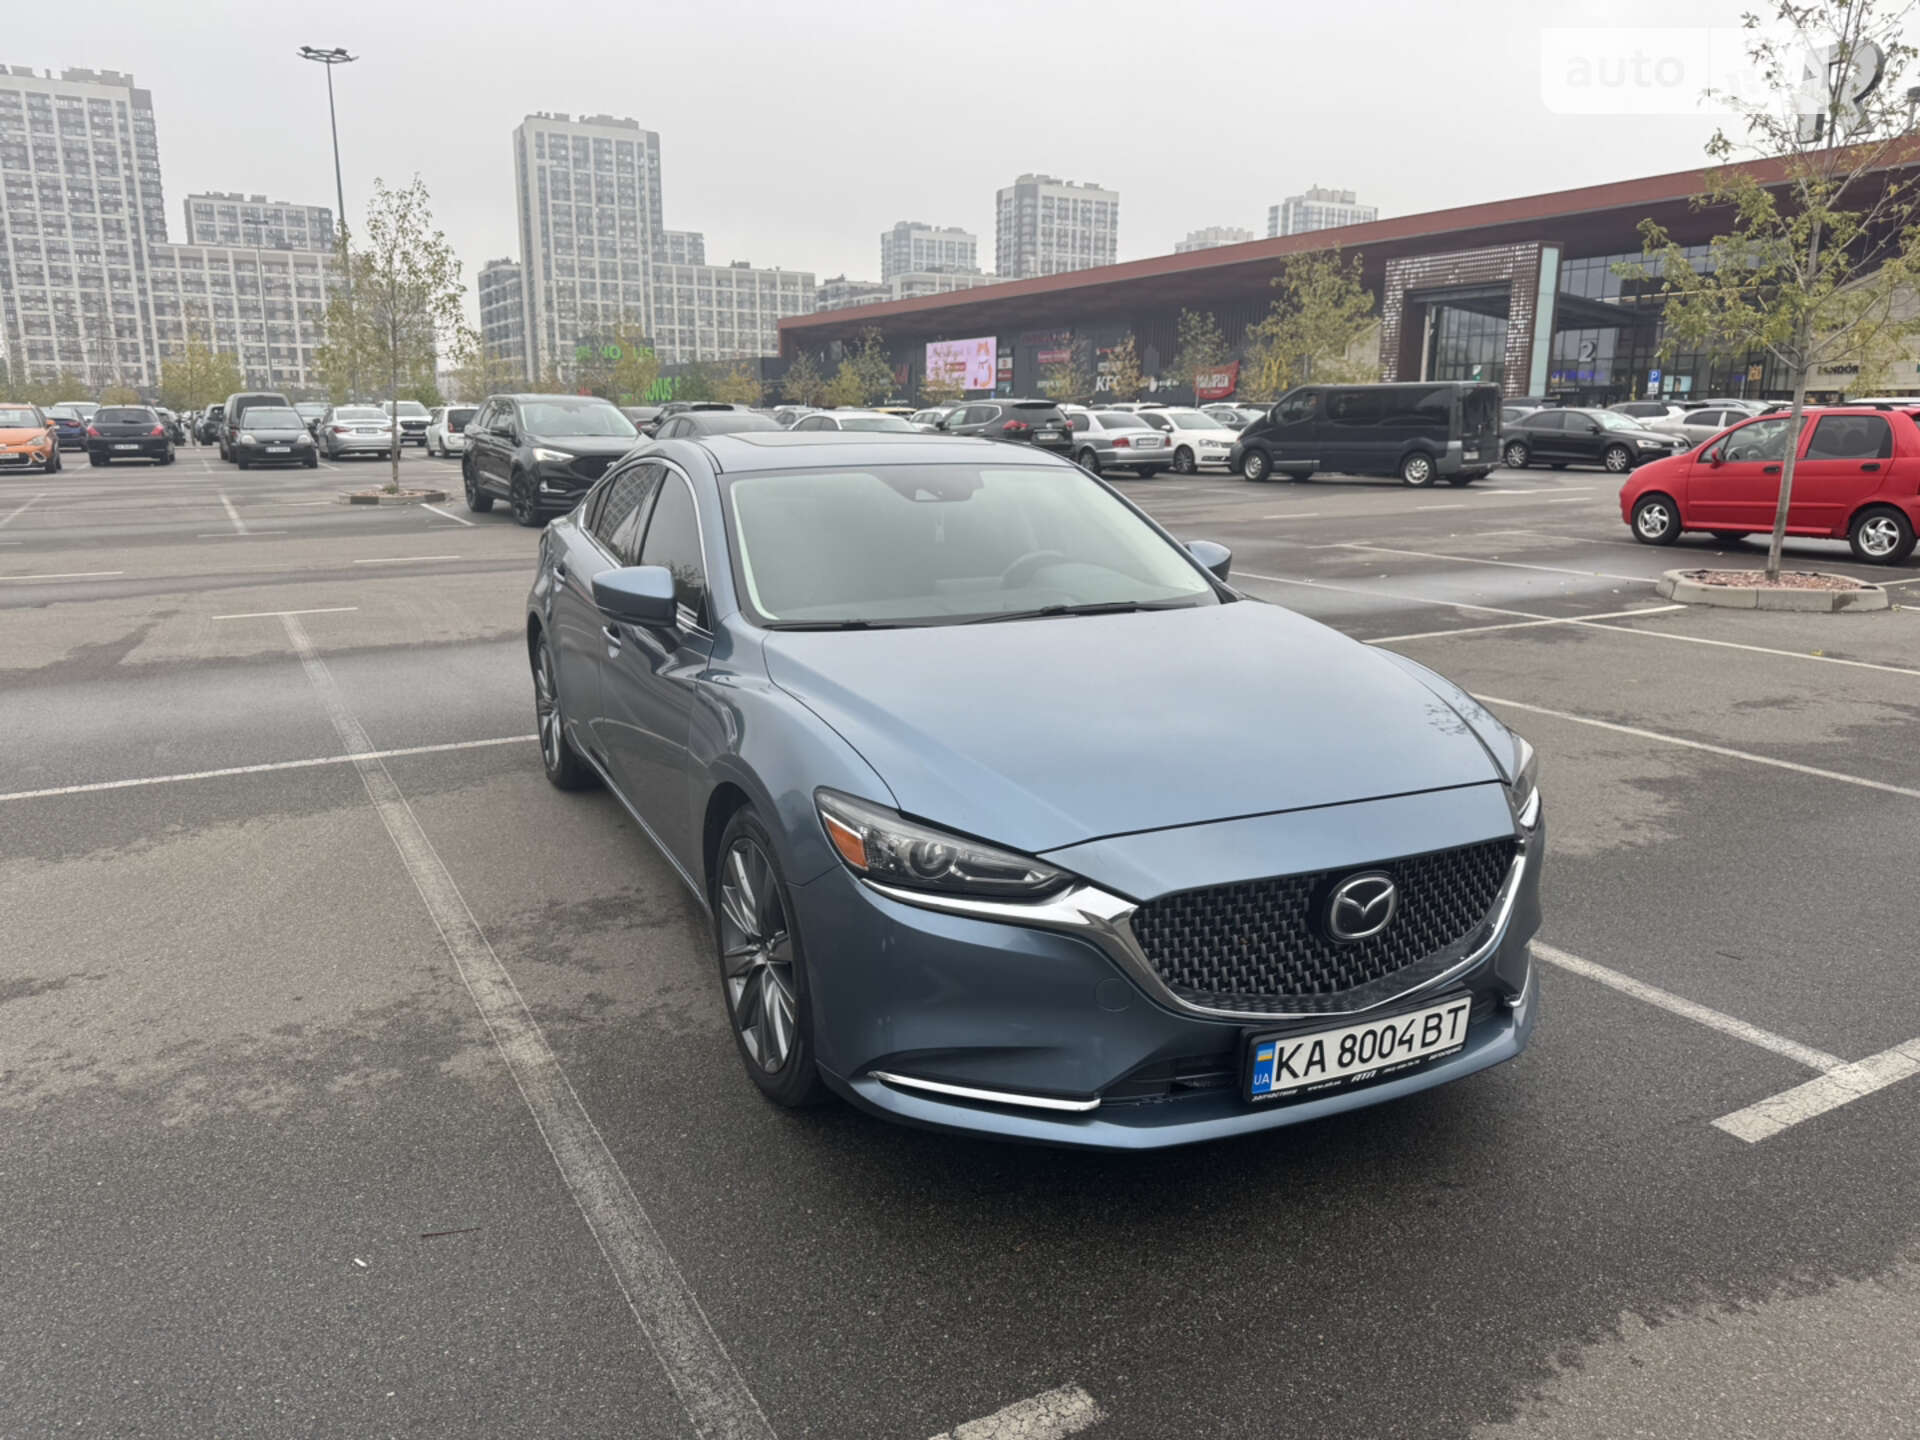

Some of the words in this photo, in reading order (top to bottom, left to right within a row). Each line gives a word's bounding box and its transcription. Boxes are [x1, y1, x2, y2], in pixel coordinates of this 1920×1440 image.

[1579, 340, 1596, 362] 2
[1275, 1039, 1326, 1082] KA
[1337, 1018, 1417, 1068] 8004
[1420, 1004, 1467, 1049] BT
[1253, 1072, 1270, 1086] UA
